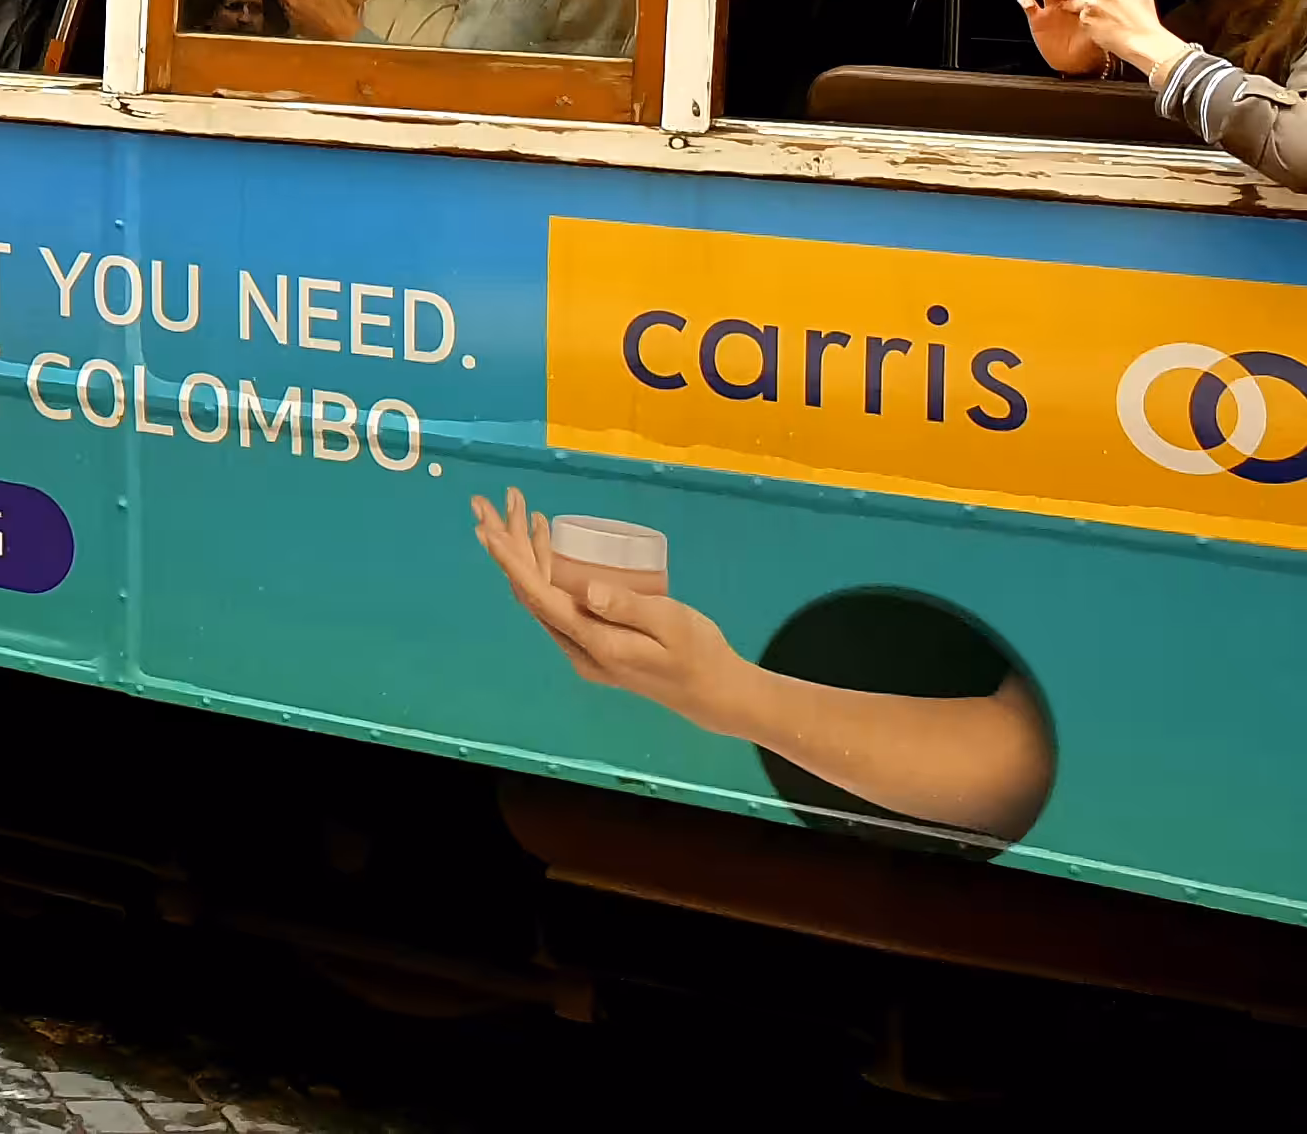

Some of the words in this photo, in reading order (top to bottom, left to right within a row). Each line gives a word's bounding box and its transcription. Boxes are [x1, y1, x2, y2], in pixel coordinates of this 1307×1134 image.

[39, 246, 201, 332] YOU
[238, 269, 476, 370] NEED.
[622, 304, 1029, 432] carris
[26, 351, 444, 477] COLOMBO.
